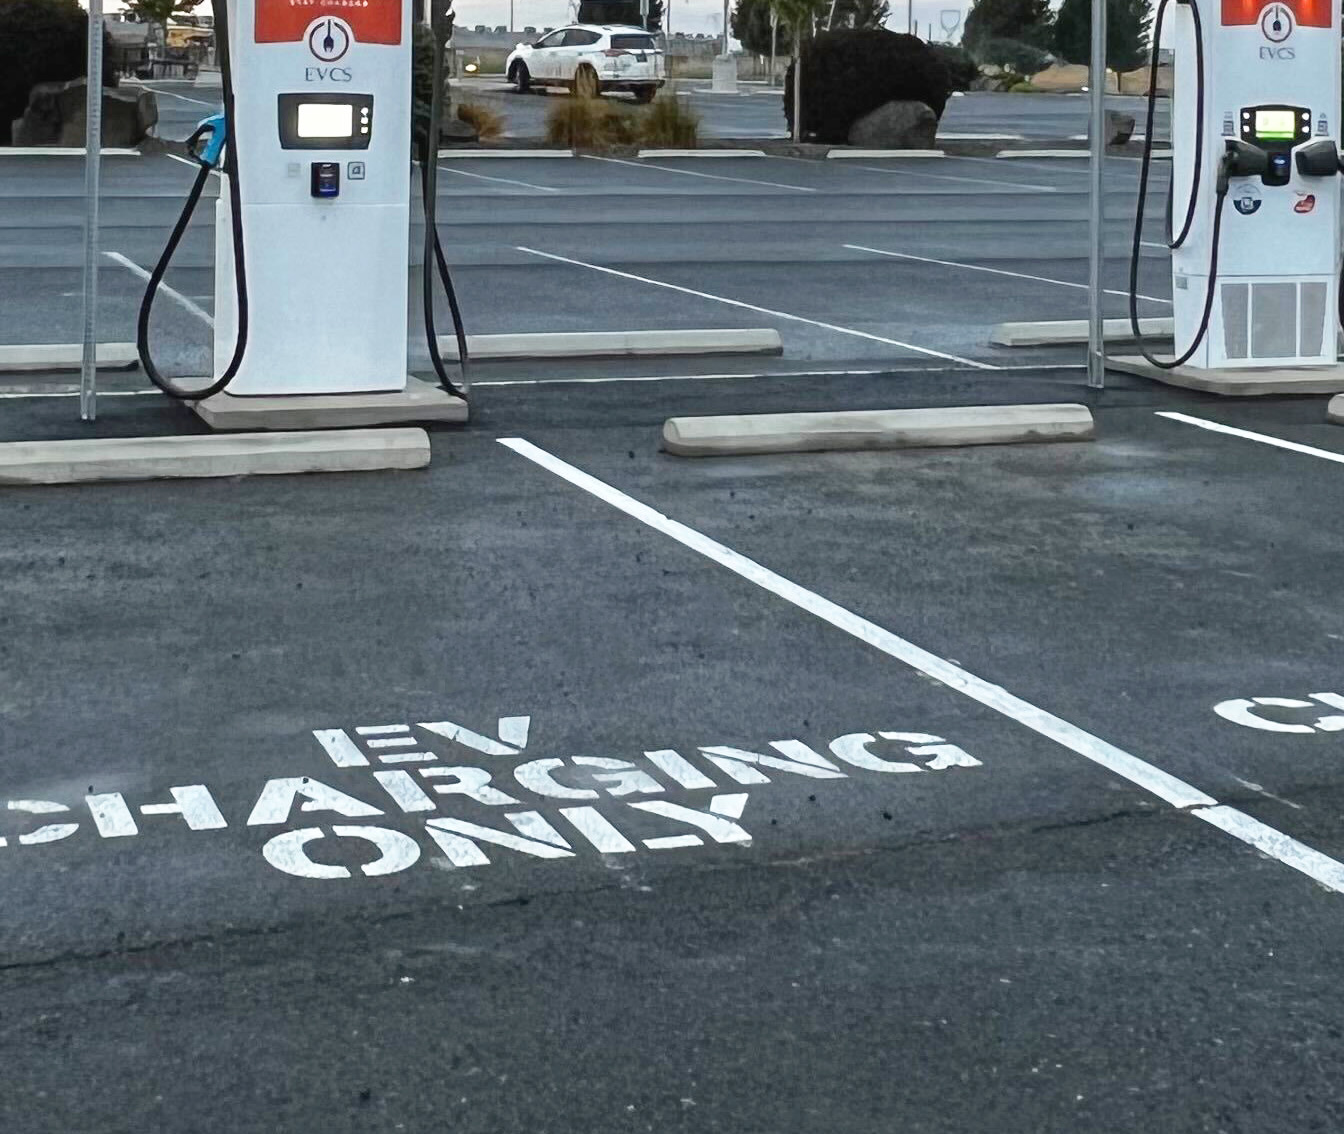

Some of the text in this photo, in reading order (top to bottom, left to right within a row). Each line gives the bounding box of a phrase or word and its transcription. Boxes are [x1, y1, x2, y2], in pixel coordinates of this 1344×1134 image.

[304, 66, 353, 83] EVCS
[312, 715, 532, 769] EV
[262, 792, 753, 880] ONLY
